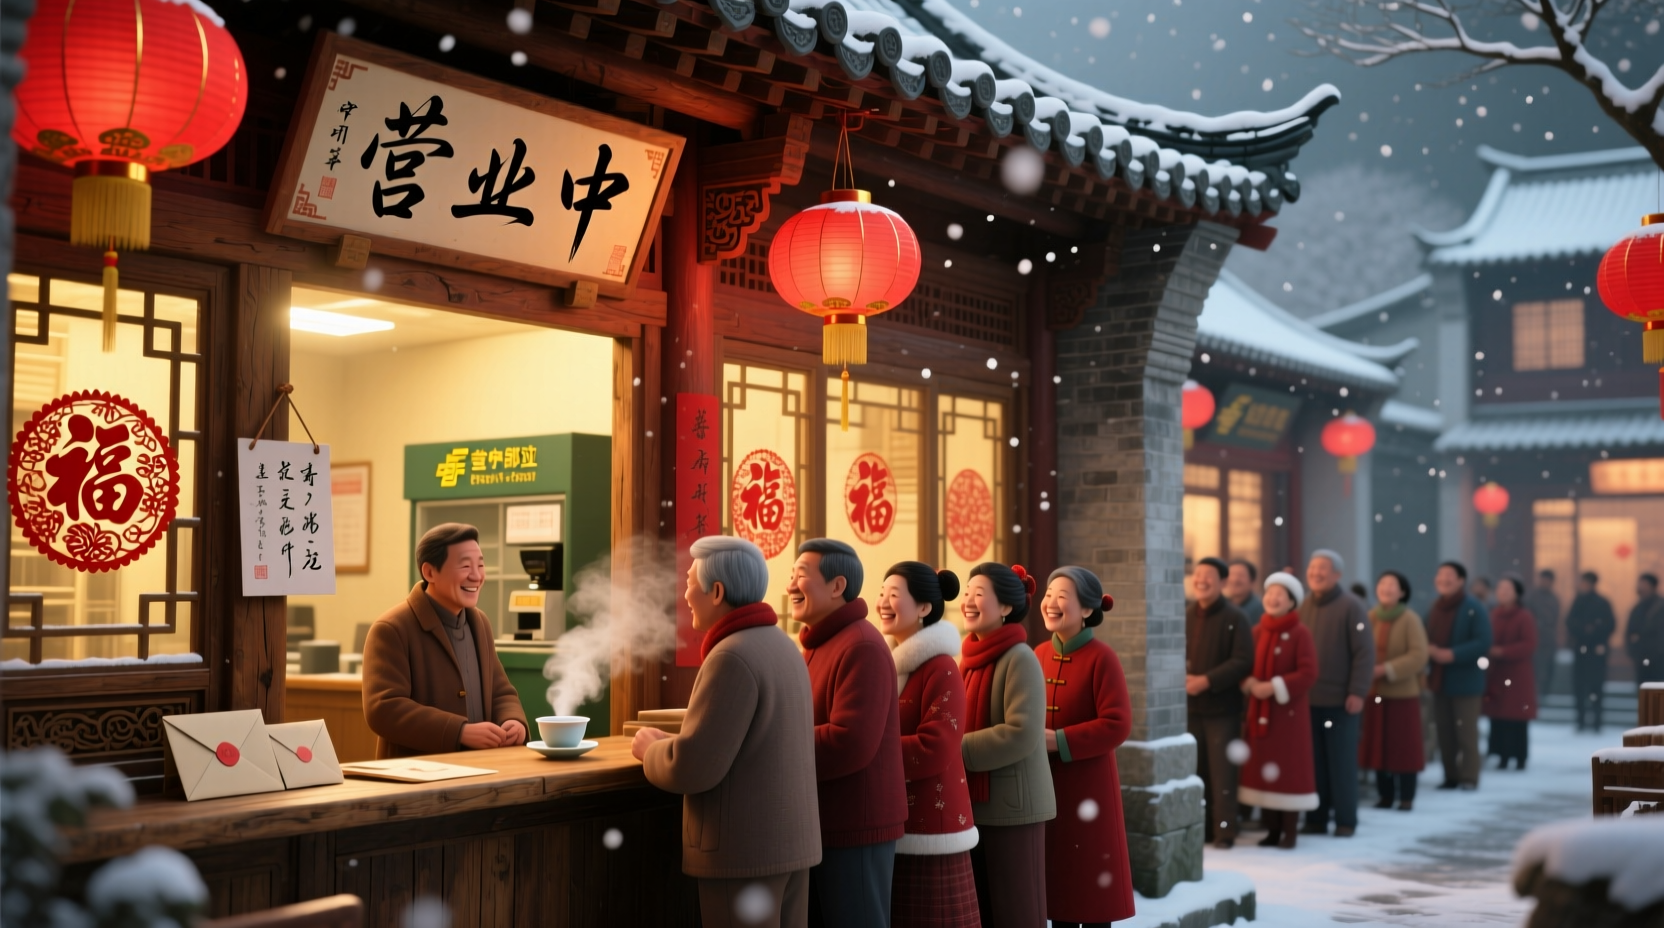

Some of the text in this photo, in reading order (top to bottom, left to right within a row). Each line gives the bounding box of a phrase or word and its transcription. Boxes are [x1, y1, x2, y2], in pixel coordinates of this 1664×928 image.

[360, 95, 630, 262] 营业中
[46, 413, 144, 525] 福
[740, 461, 785, 531] 福
[848, 460, 893, 534] 福
